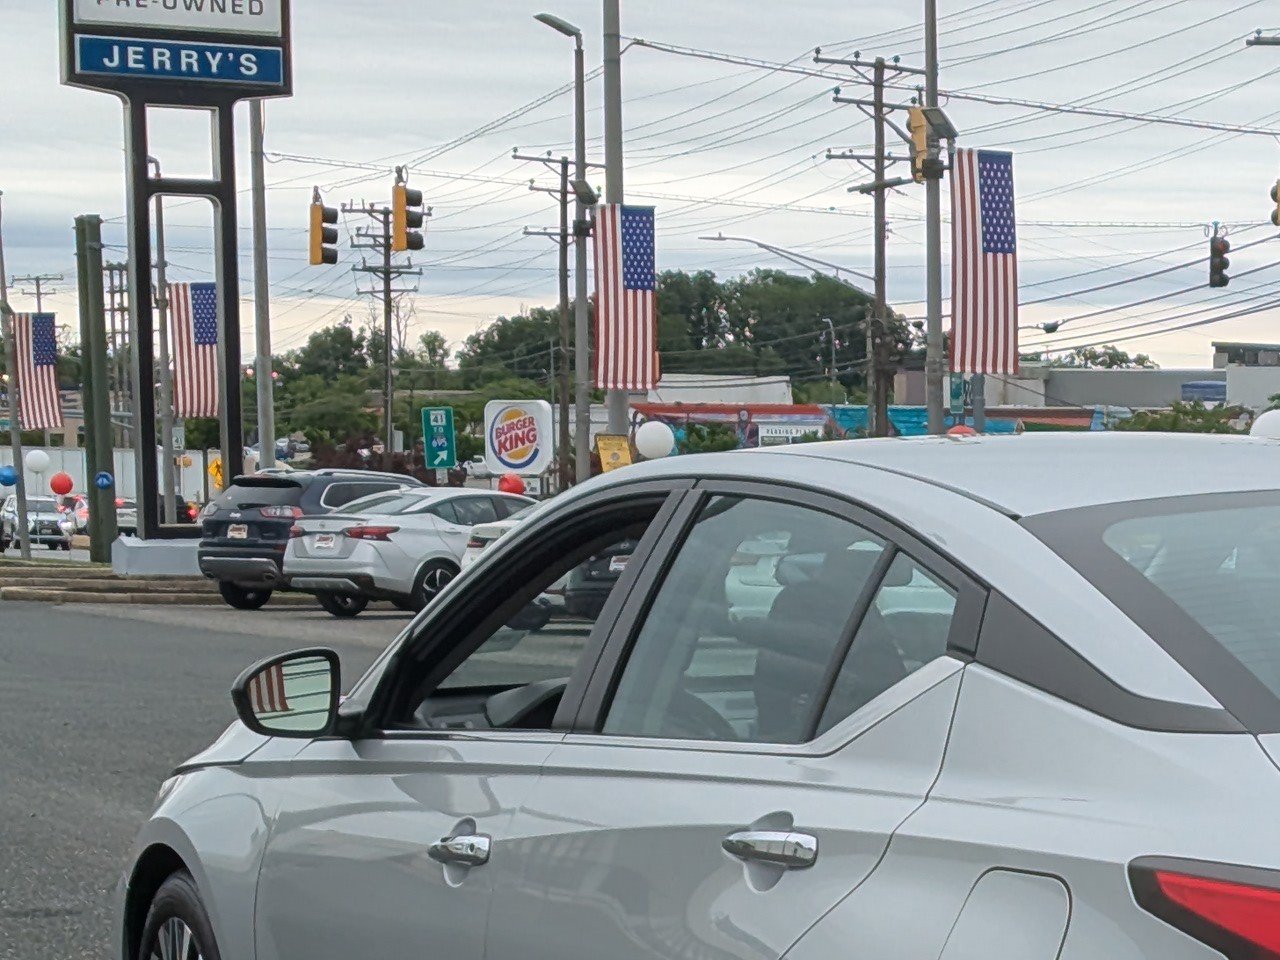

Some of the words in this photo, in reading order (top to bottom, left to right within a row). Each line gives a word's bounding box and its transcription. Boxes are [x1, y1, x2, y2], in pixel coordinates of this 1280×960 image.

[102, 44, 259, 76] JERRY'S
[495, 415, 536, 441] BURGER
[496, 427, 537, 456] KING
